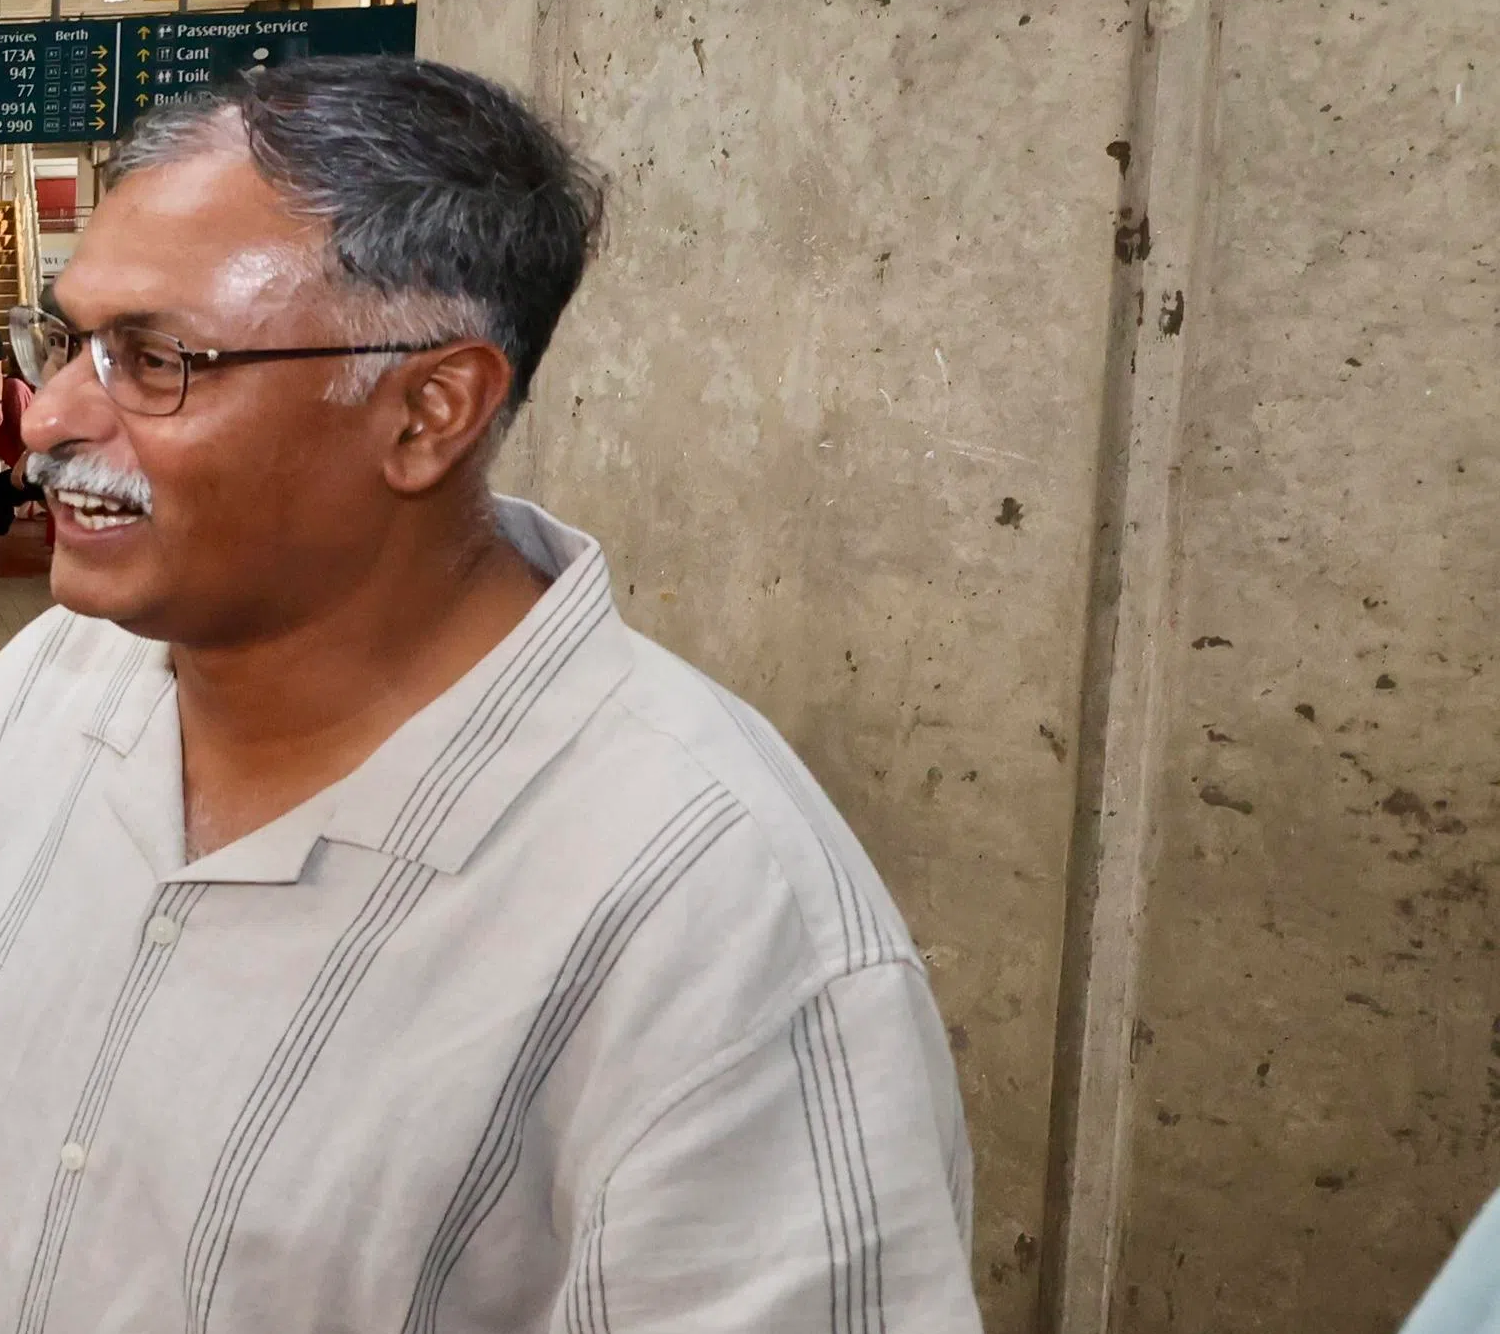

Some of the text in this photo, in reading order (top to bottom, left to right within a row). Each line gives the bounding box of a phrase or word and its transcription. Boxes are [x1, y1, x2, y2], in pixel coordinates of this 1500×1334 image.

[177, 20, 308, 37] Passenger Service
[56, 29, 88, 41] Berth
[2, 49, 35, 62] 173A
[177, 47, 209, 60] Cant
[10, 67, 35, 80] 947
[18, 85, 34, 97] 77
[1, 103, 36, 115] 991A
[7, 120, 32, 132] 990
